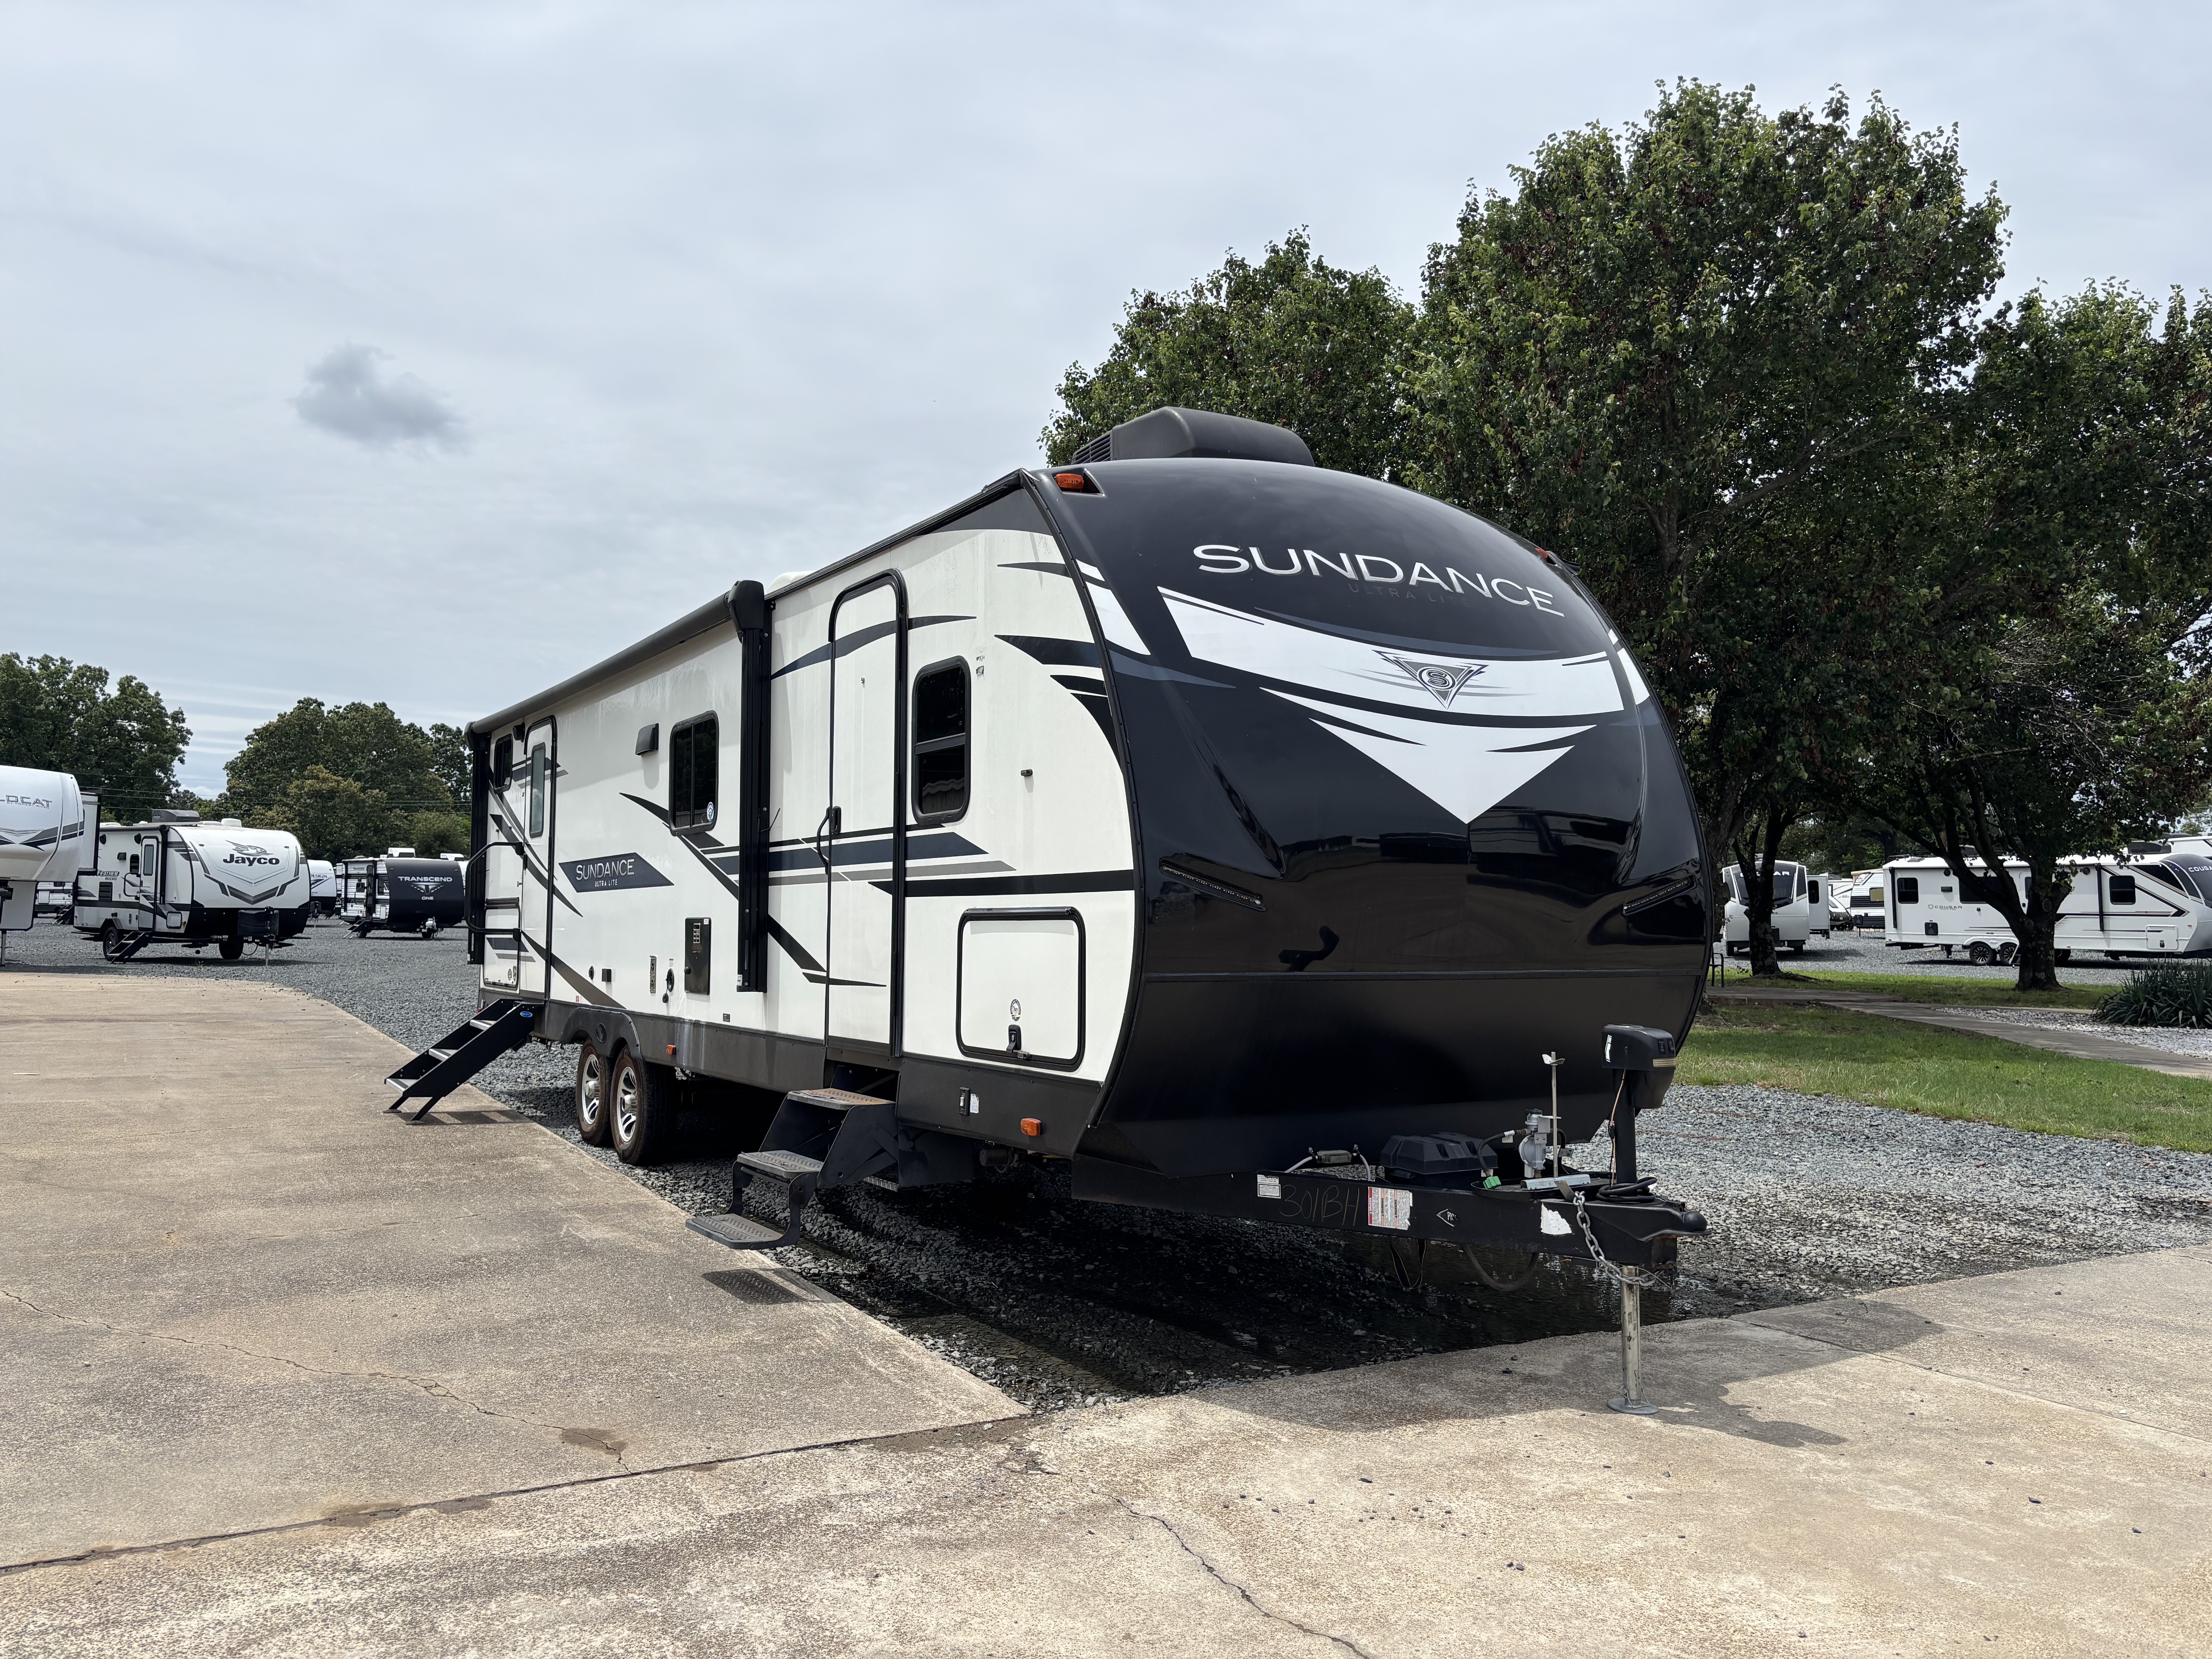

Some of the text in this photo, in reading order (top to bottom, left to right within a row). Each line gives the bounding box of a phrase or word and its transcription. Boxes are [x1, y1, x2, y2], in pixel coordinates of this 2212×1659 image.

[1193, 544, 1565, 618] SUNDANCE
[1348, 583, 1416, 599] ULTRA
[223, 854, 280, 866] Jayco
[576, 859, 635, 881] SUNDANCE
